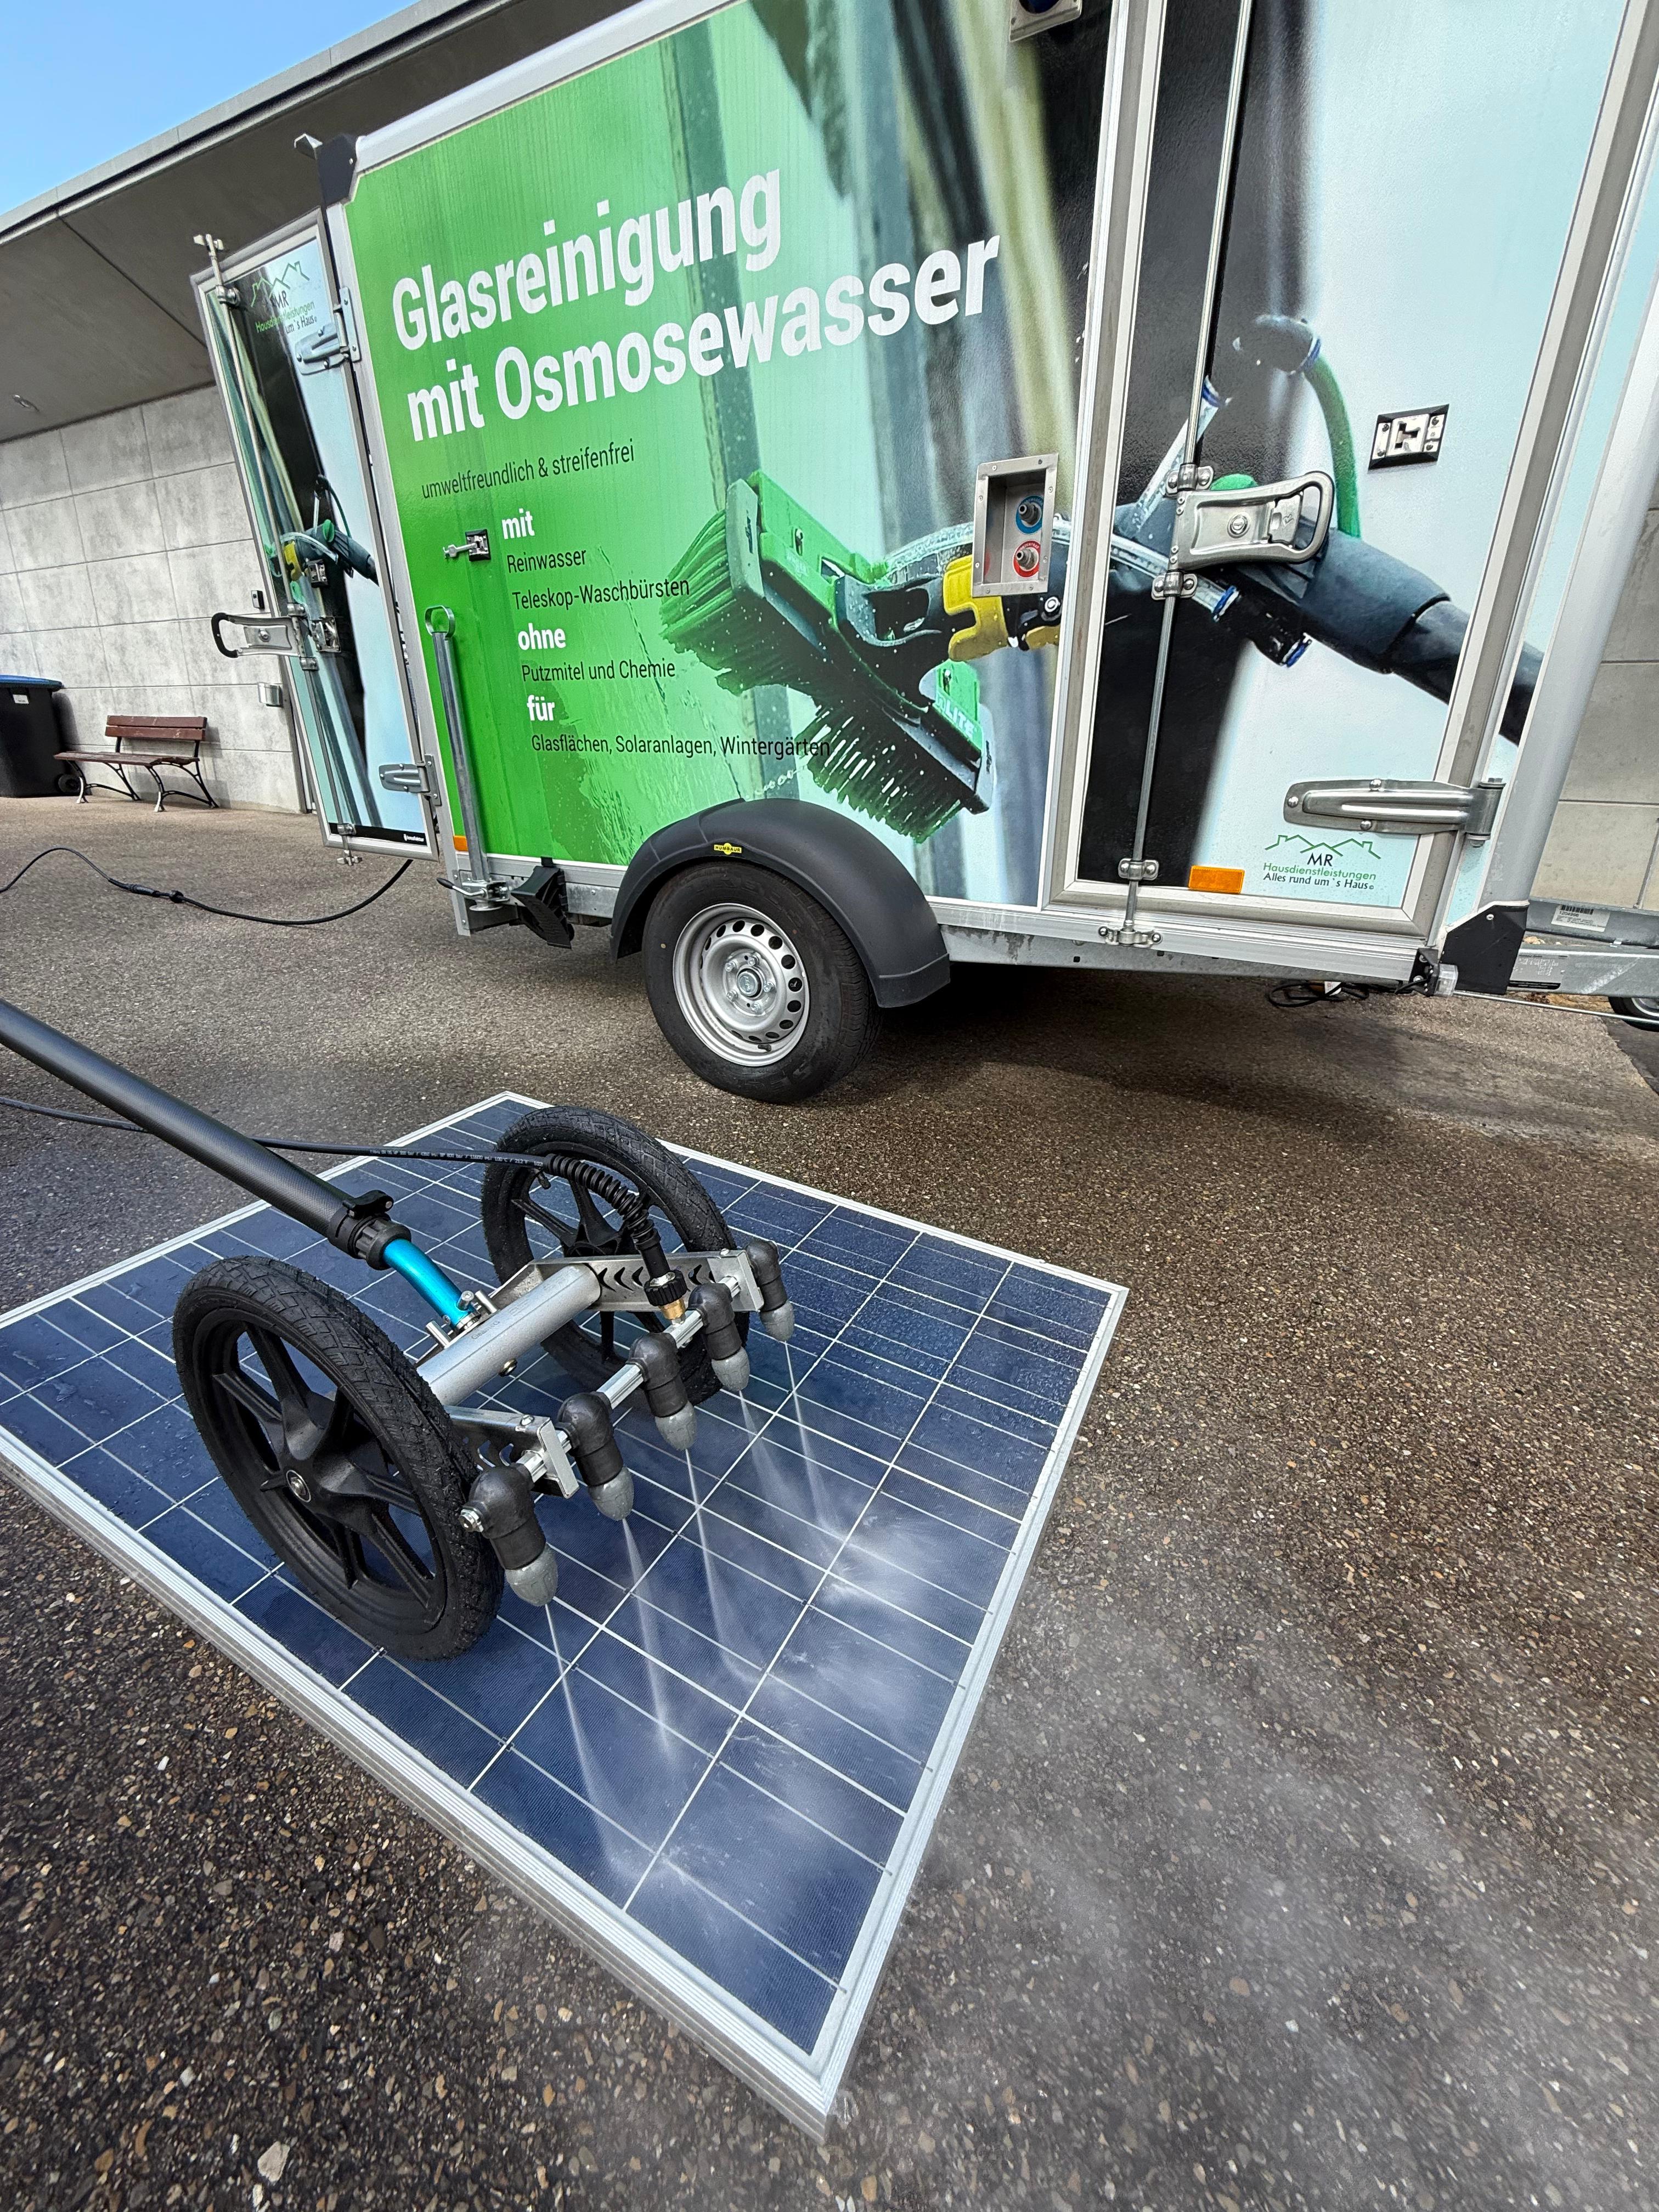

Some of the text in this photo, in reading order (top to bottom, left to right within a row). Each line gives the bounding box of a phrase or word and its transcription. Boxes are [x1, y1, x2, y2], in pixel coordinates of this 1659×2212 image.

[392, 169, 781, 351] Glasreinigung
[408, 235, 1000, 442] mit Osmosewasser
[422, 439, 635, 499] umweltfreundlich & streifenfrei
[501, 508, 535, 539] mit
[507, 550, 586, 574] Reinwasser
[512, 579, 690, 610] Teleskop-Waschbürsten
[518, 623, 566, 650] ohne
[522, 657, 675, 682] Putzmitel und Chemie
[527, 695, 555, 721] für
[532, 733, 830, 760] Glasflächen, Solaranlagen, Wintergärten
[1263, 862, 1376, 881] Hausdienstleistungen
[1307, 853, 1333, 866] MR
[1263, 872, 1286, 882] Alles
[1289, 876, 1312, 884] rund
